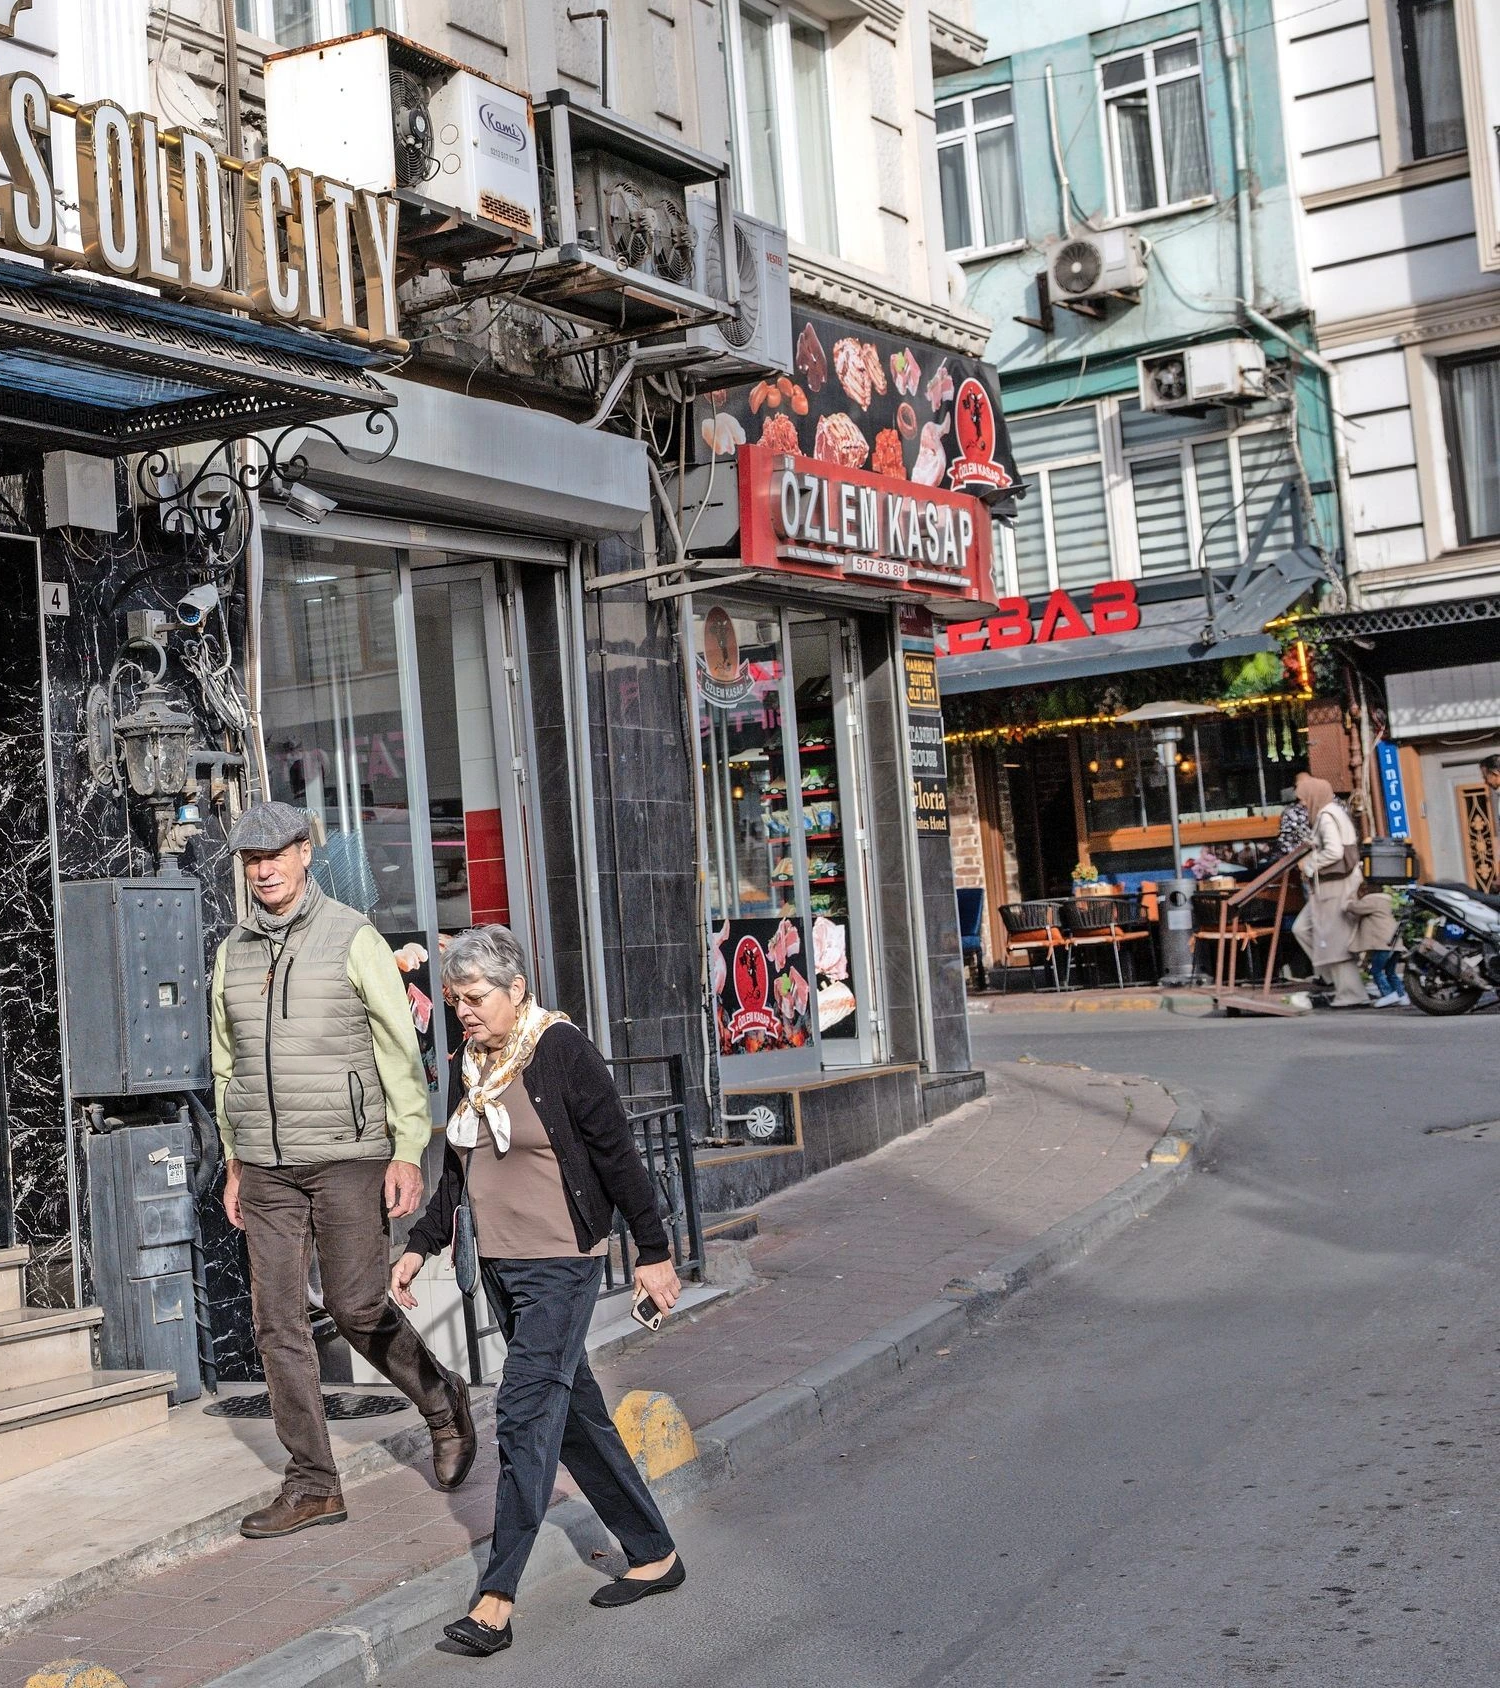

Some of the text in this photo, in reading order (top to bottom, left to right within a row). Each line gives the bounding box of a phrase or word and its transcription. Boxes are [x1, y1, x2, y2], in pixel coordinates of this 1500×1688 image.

[487, 111, 520, 138] Kami
[88, 99, 228, 292] OLD
[254, 157, 400, 344] CITY
[781, 454, 973, 568] ÖZLEM KASAP
[857, 558, 905, 577] 517 83 89
[51, 587, 62, 610] 4
[934, 580, 1141, 658] EBAB
[905, 659, 934, 673] HARBOUR
[704, 680, 744, 698] ÖZLEM KASAP
[910, 673, 932, 687] SUITES
[908, 687, 936, 701] OLD CITY
[929, 816, 947, 830] Hotel
